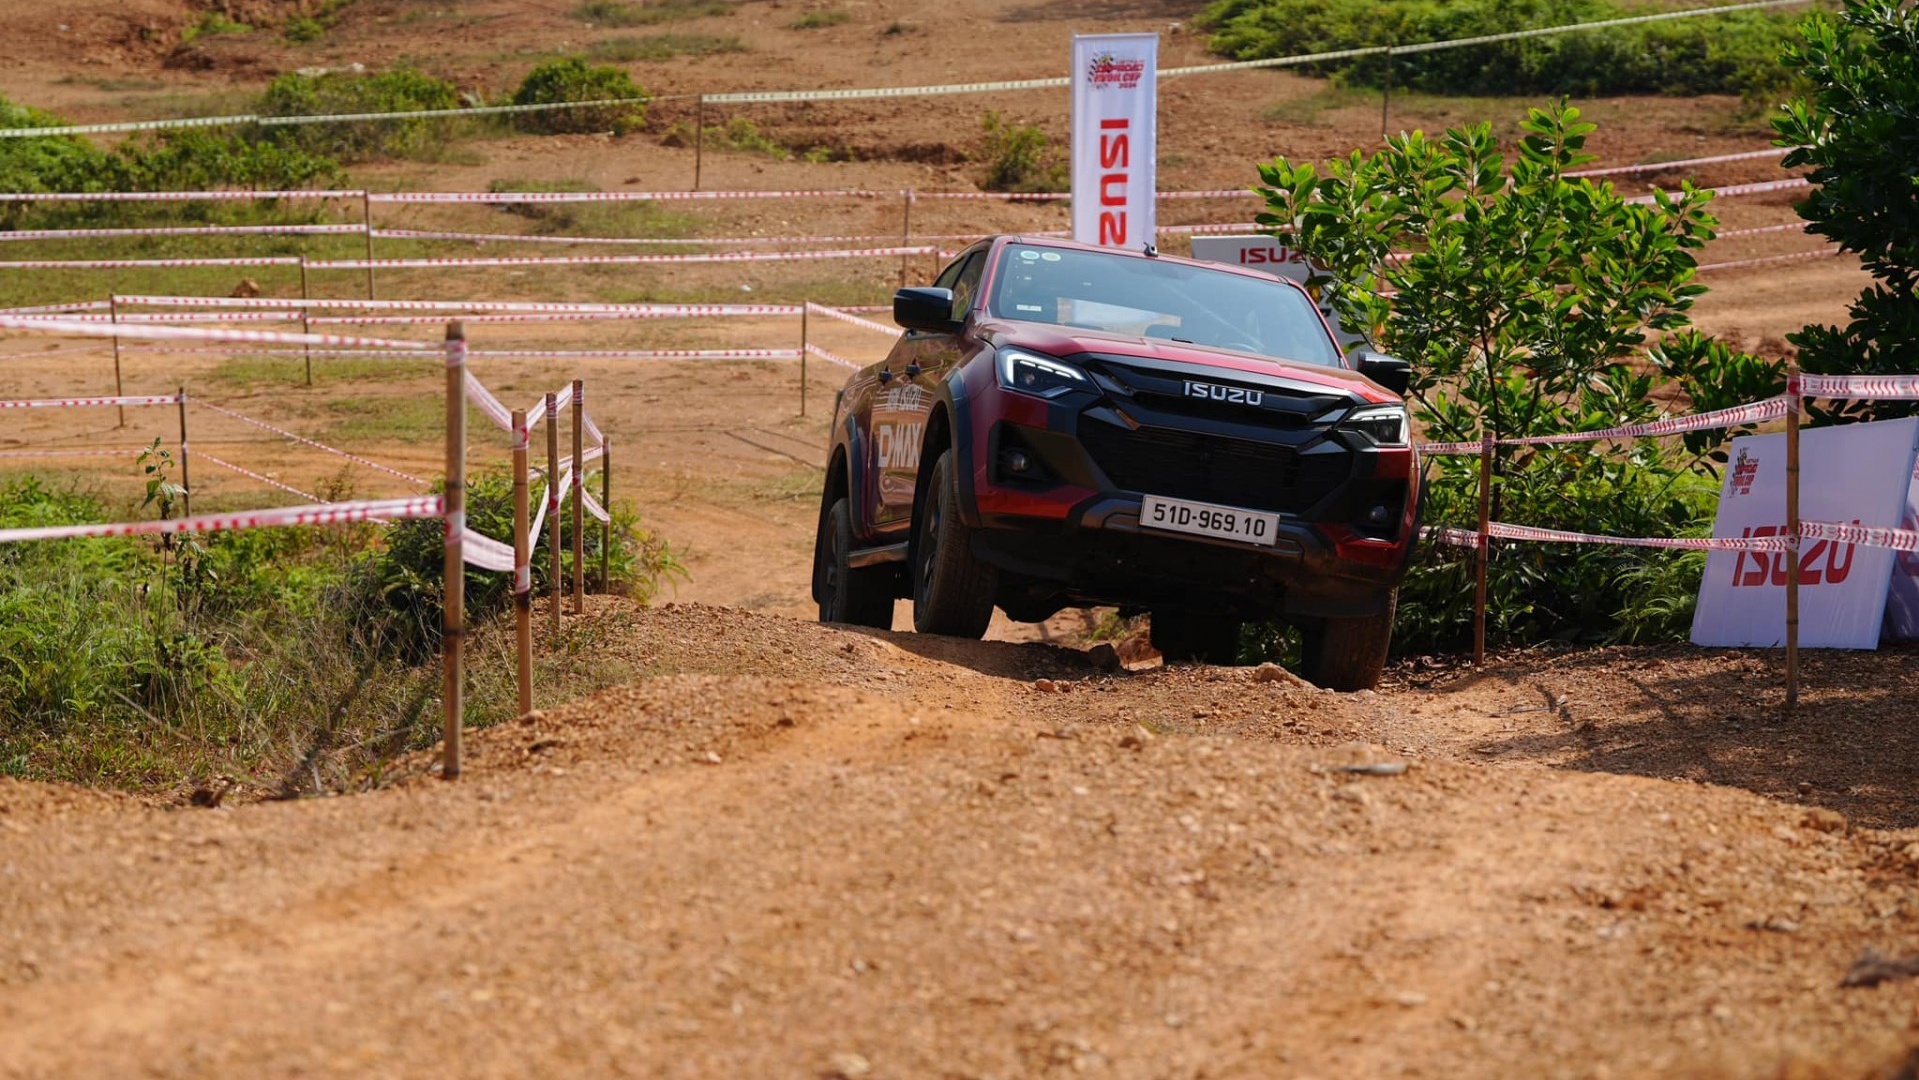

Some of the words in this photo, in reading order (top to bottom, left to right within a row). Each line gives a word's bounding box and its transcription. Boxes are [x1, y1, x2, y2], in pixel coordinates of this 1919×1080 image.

[1099, 118, 1128, 246] ISUZ
[1240, 247, 1304, 264] ISUZ
[1184, 381, 1262, 406] ISUZU
[1153, 503, 1266, 537] 51D-969.10
